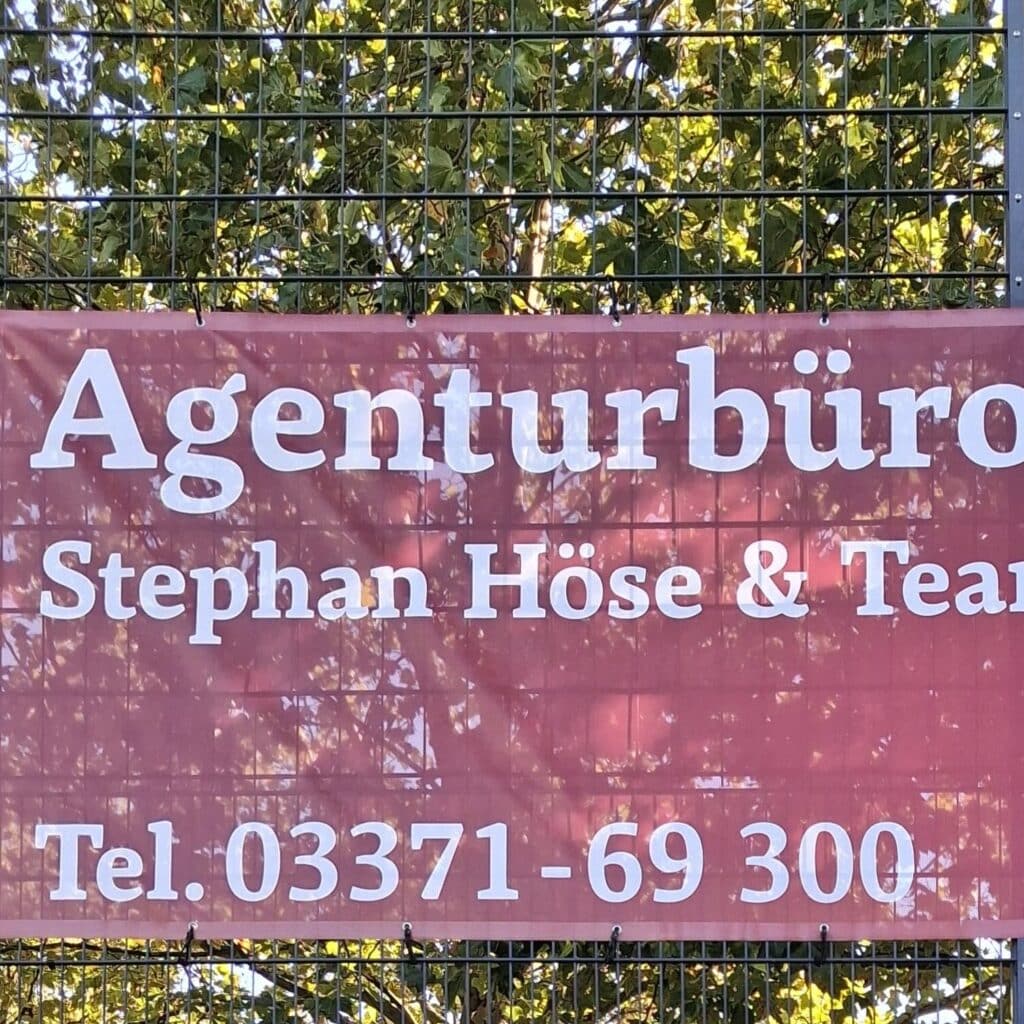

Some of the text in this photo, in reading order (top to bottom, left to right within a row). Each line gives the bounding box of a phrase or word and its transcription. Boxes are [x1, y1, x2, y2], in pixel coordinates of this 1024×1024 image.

[39, 540, 433, 645] Stephan
[463, 542, 703, 620] Höse
[736, 540, 809, 619] &
[34, 820, 205, 902] Tel.
[740, 821, 915, 904] 300
